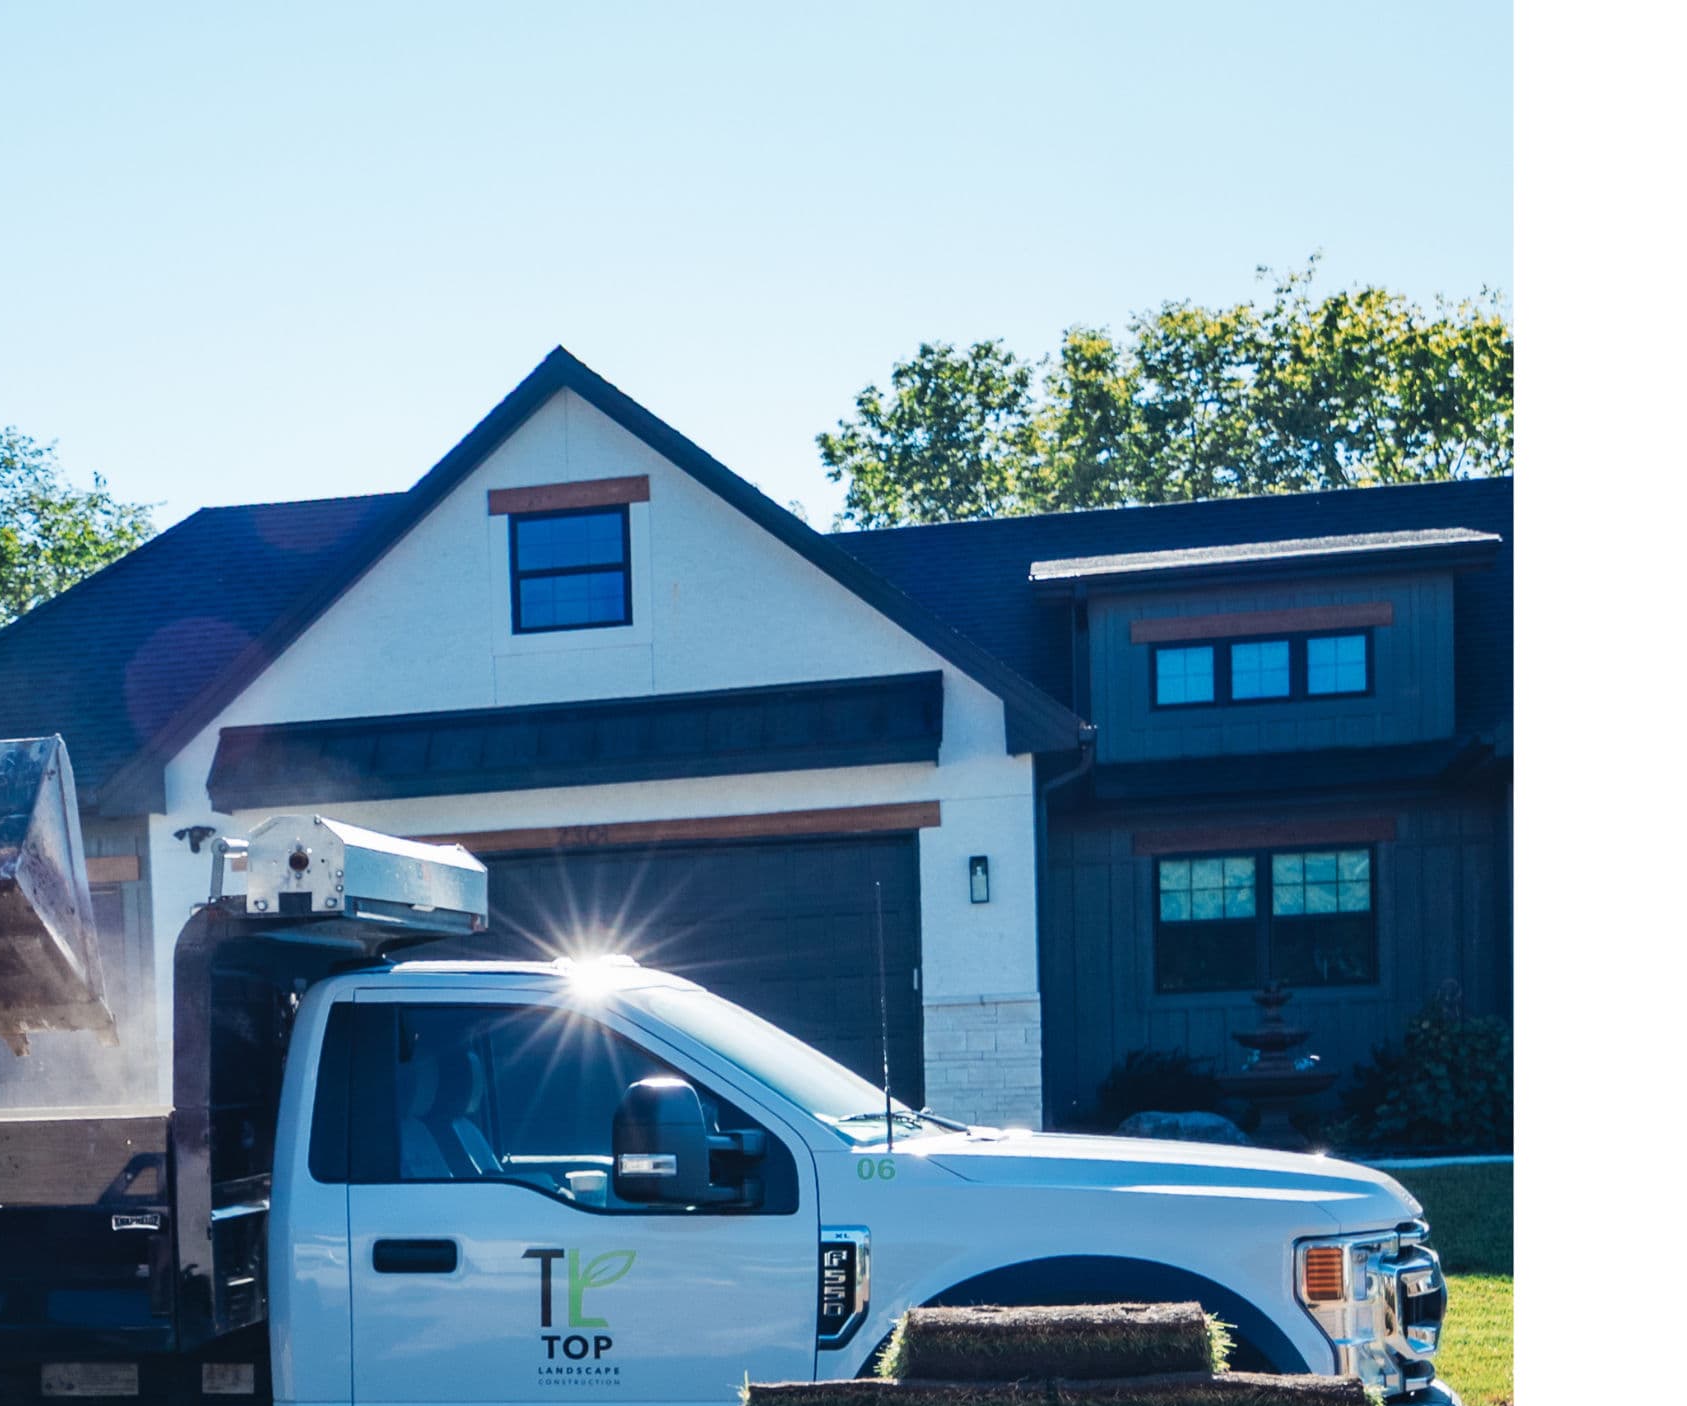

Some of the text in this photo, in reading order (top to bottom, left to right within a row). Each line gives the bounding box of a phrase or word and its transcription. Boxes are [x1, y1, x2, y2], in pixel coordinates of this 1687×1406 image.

[856, 1157, 896, 1181] 06
[521, 1248, 637, 1328] TL
[541, 1334, 613, 1360] TOP
[538, 1367, 620, 1375] LANDSCAPE
[538, 1378, 621, 1386] CONSTRUCTION
